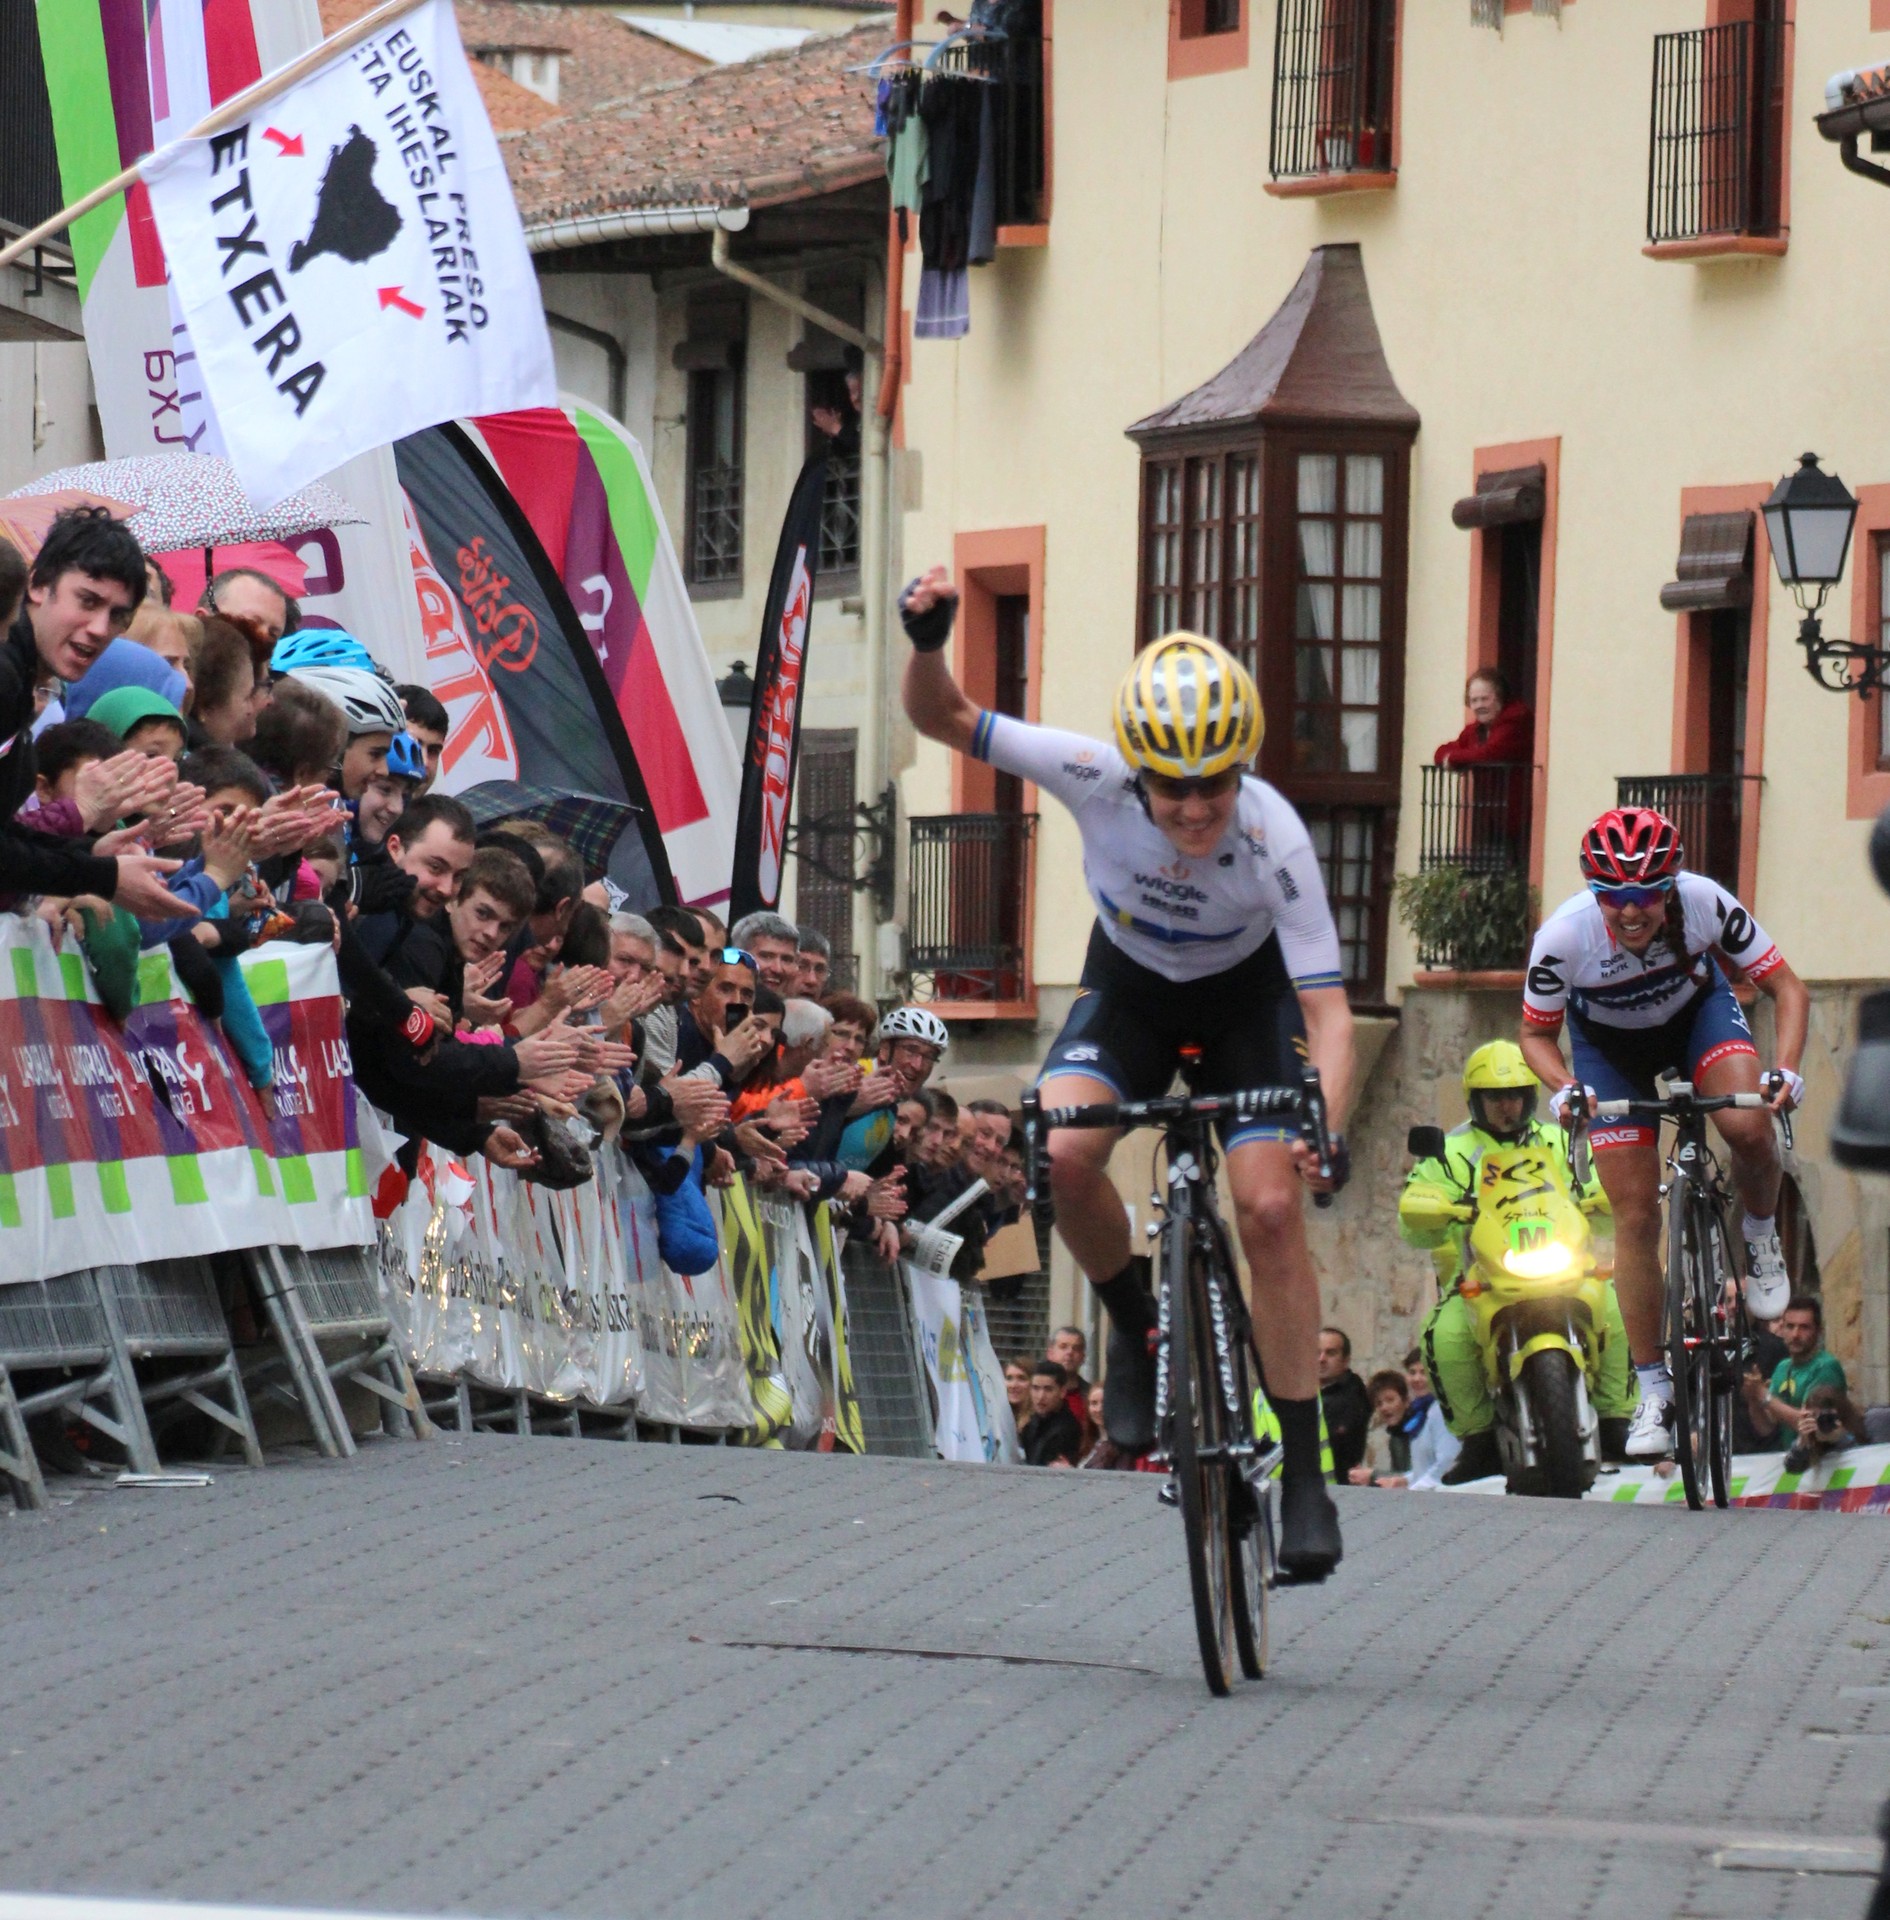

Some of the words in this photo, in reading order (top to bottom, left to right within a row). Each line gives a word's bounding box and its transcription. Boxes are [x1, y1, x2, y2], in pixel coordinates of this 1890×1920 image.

[384, 28, 458, 175] EUSKAL
[448, 192, 489, 331] PRESO
[384, 103, 470, 345] IHESLARIAK
[209, 123, 327, 419] ETXERA
[1062, 761, 1102, 782] wiggle
[1134, 873, 1209, 904] wiggle
[1701, 1042, 1757, 1067] ROTOR
[1518, 1226, 1547, 1253] M
[1155, 1282, 1171, 1418] COLNAGO
[1208, 1280, 1239, 1413] COLNAGO
